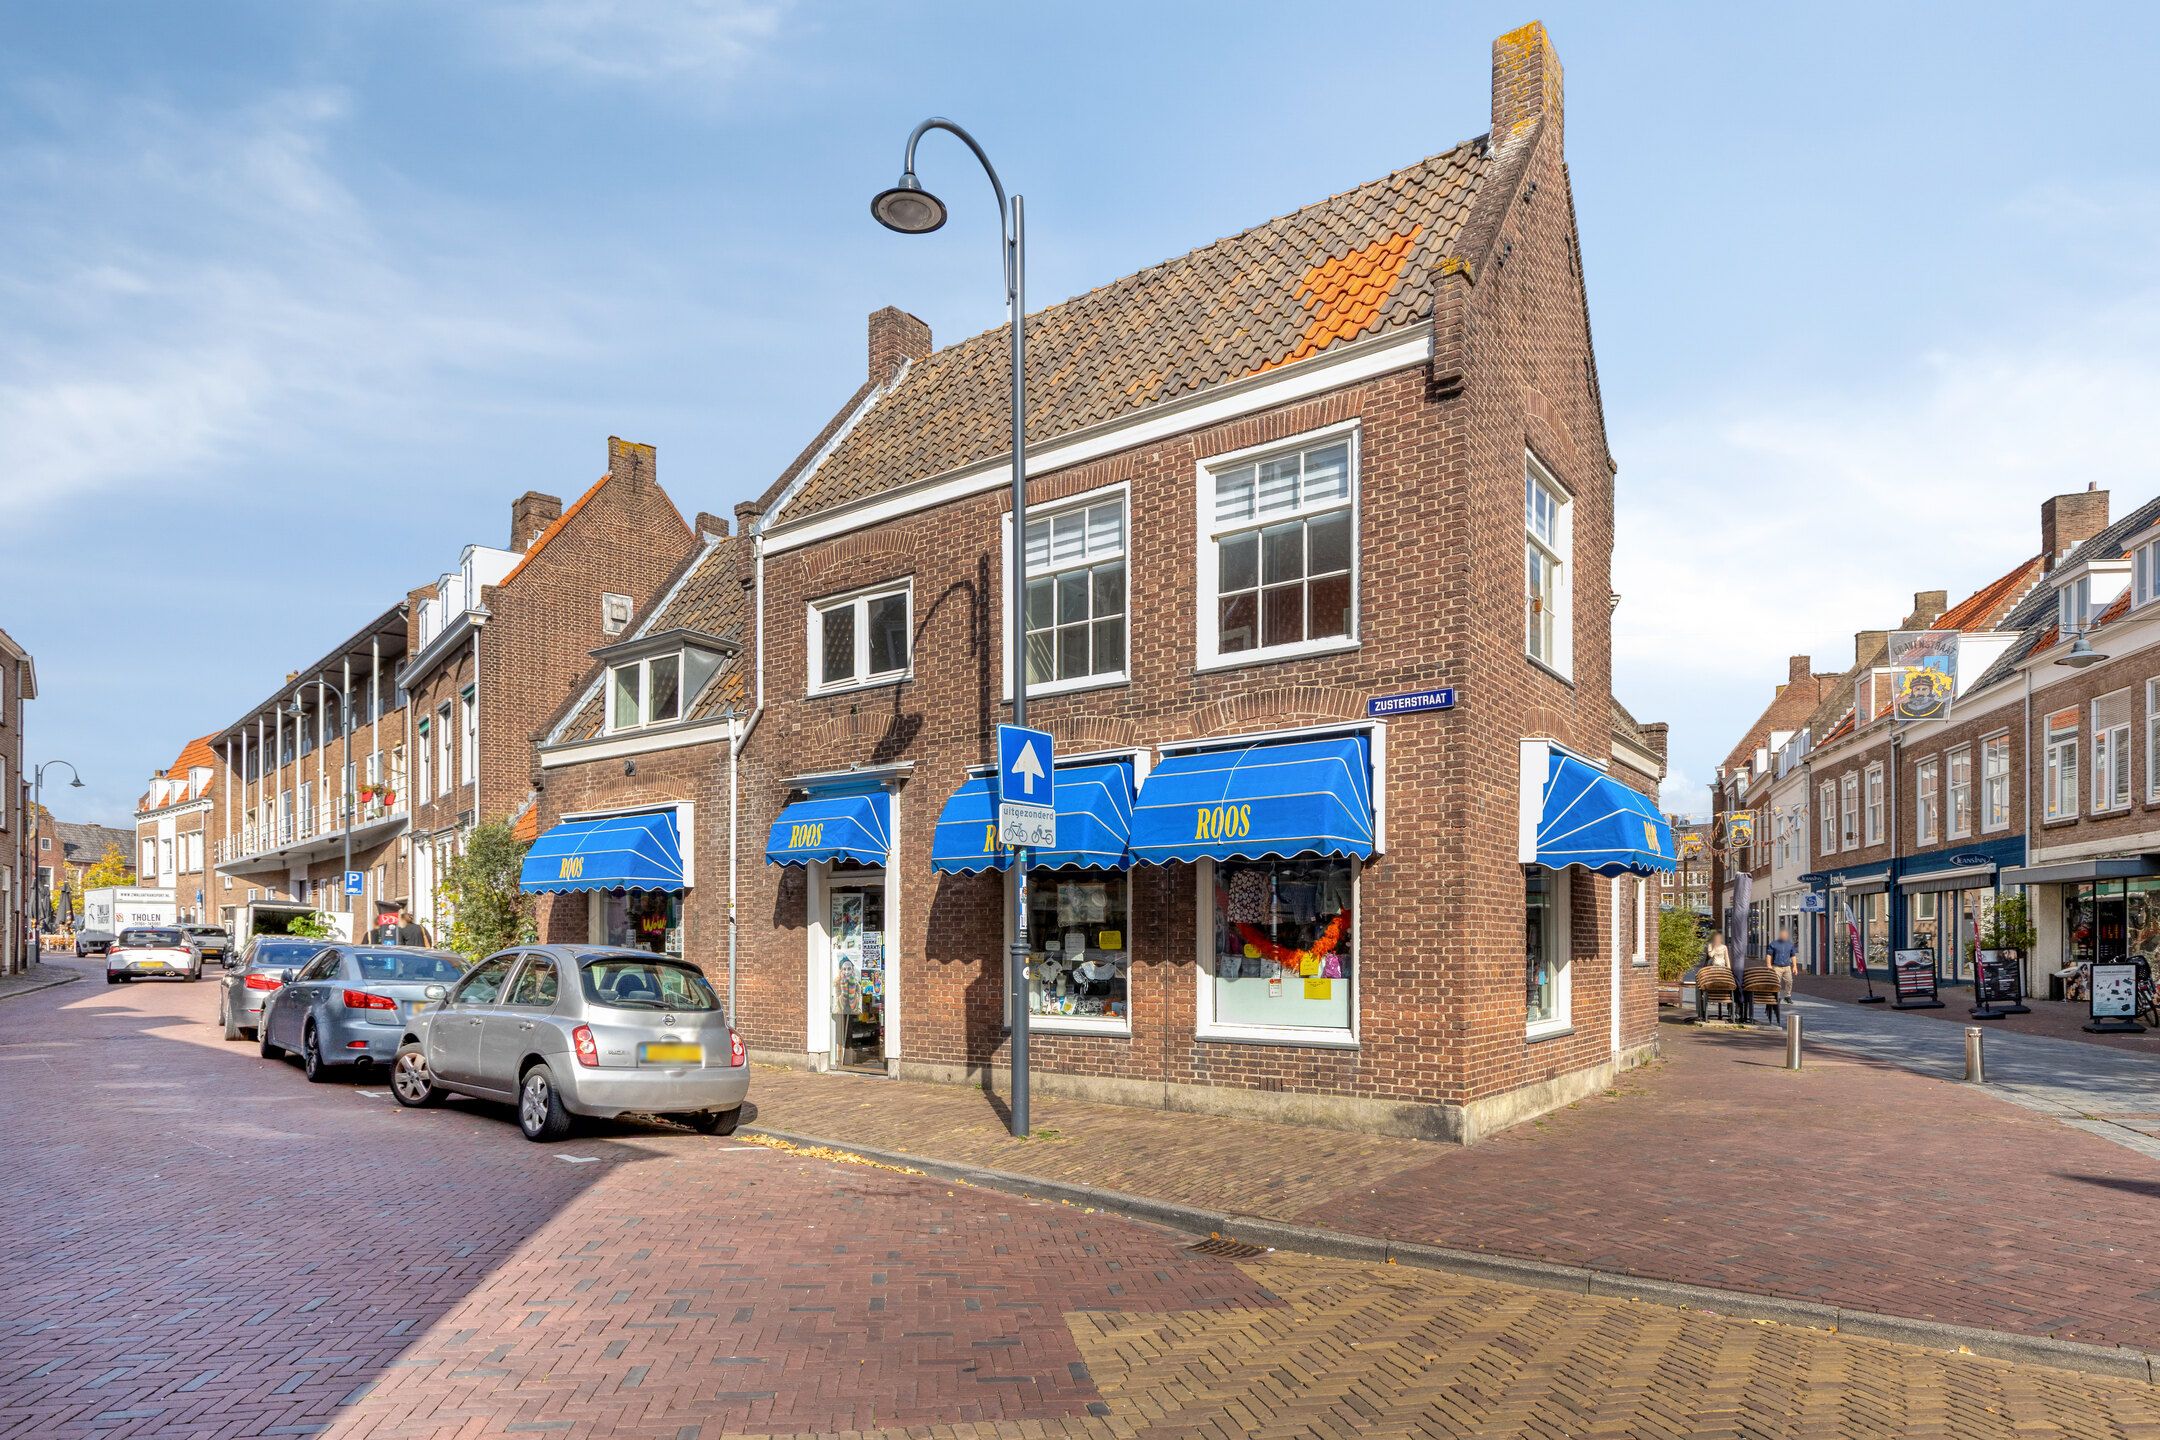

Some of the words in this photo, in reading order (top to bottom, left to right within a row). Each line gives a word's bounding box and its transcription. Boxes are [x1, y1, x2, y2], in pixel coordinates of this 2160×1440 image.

[1374, 692, 1447, 712] ZUSTERSTRAAT
[1003, 807, 1054, 820] uitgezonderd
[1194, 804, 1251, 840] ROOS
[788, 822, 824, 849] ROOS
[559, 856, 585, 879] ROOS
[348, 873, 360, 886] P
[132, 913, 161, 921] THOLEN
